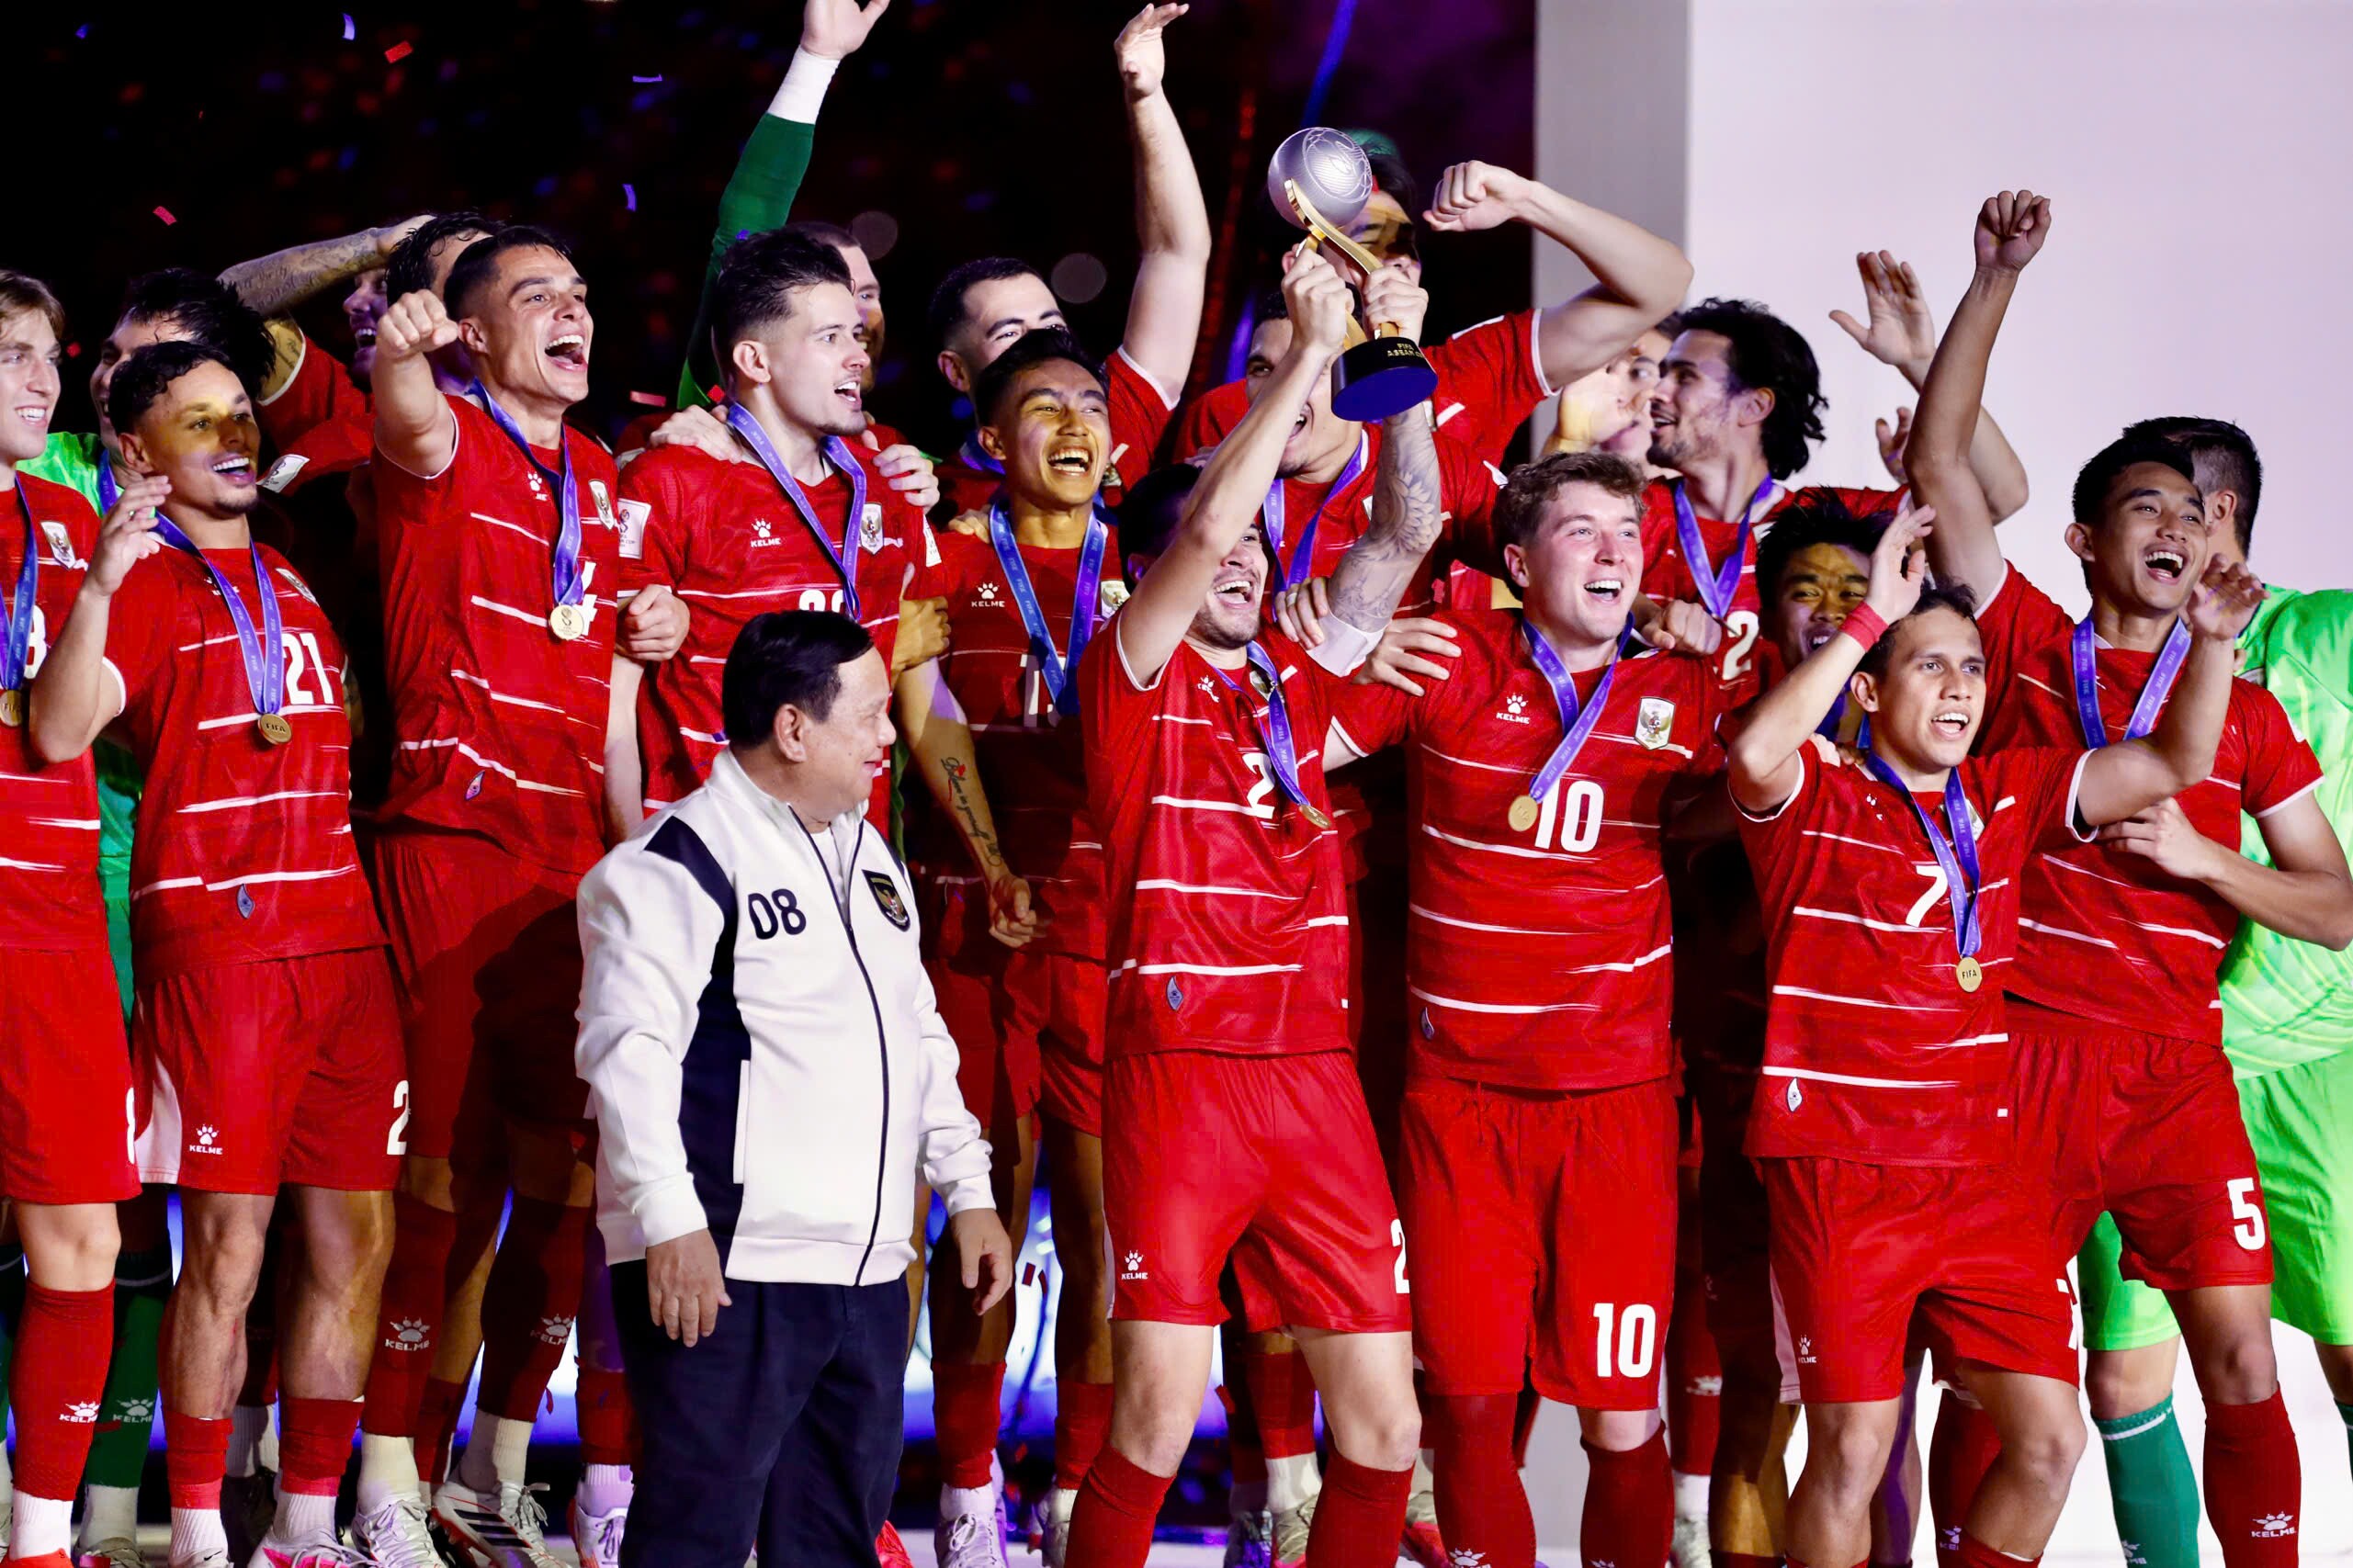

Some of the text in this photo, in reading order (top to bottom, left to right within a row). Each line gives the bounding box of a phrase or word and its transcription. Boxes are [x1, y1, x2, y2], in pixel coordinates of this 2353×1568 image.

[751, 537, 781, 547] KELME
[971, 600, 1006, 608] KELME
[1713, 610, 1759, 681] 2
[281, 633, 334, 705] 21
[266, 722, 286, 733] FIFA
[1496, 712, 1530, 725] KELME
[1242, 752, 1276, 819] 2
[1534, 778, 1604, 853] 10
[1906, 864, 1948, 928] 7
[748, 888, 807, 940] 08
[1962, 969, 1977, 978] FIFA
[189, 1145, 222, 1155] KELME
[2227, 1178, 2267, 1250] 5
[1390, 1219, 1410, 1293] 2
[385, 1338, 430, 1351] KELME
[1593, 1303, 1657, 1378] 10
[59, 1414, 98, 1423] KELM
[2251, 1527, 2295, 1538] KELME
